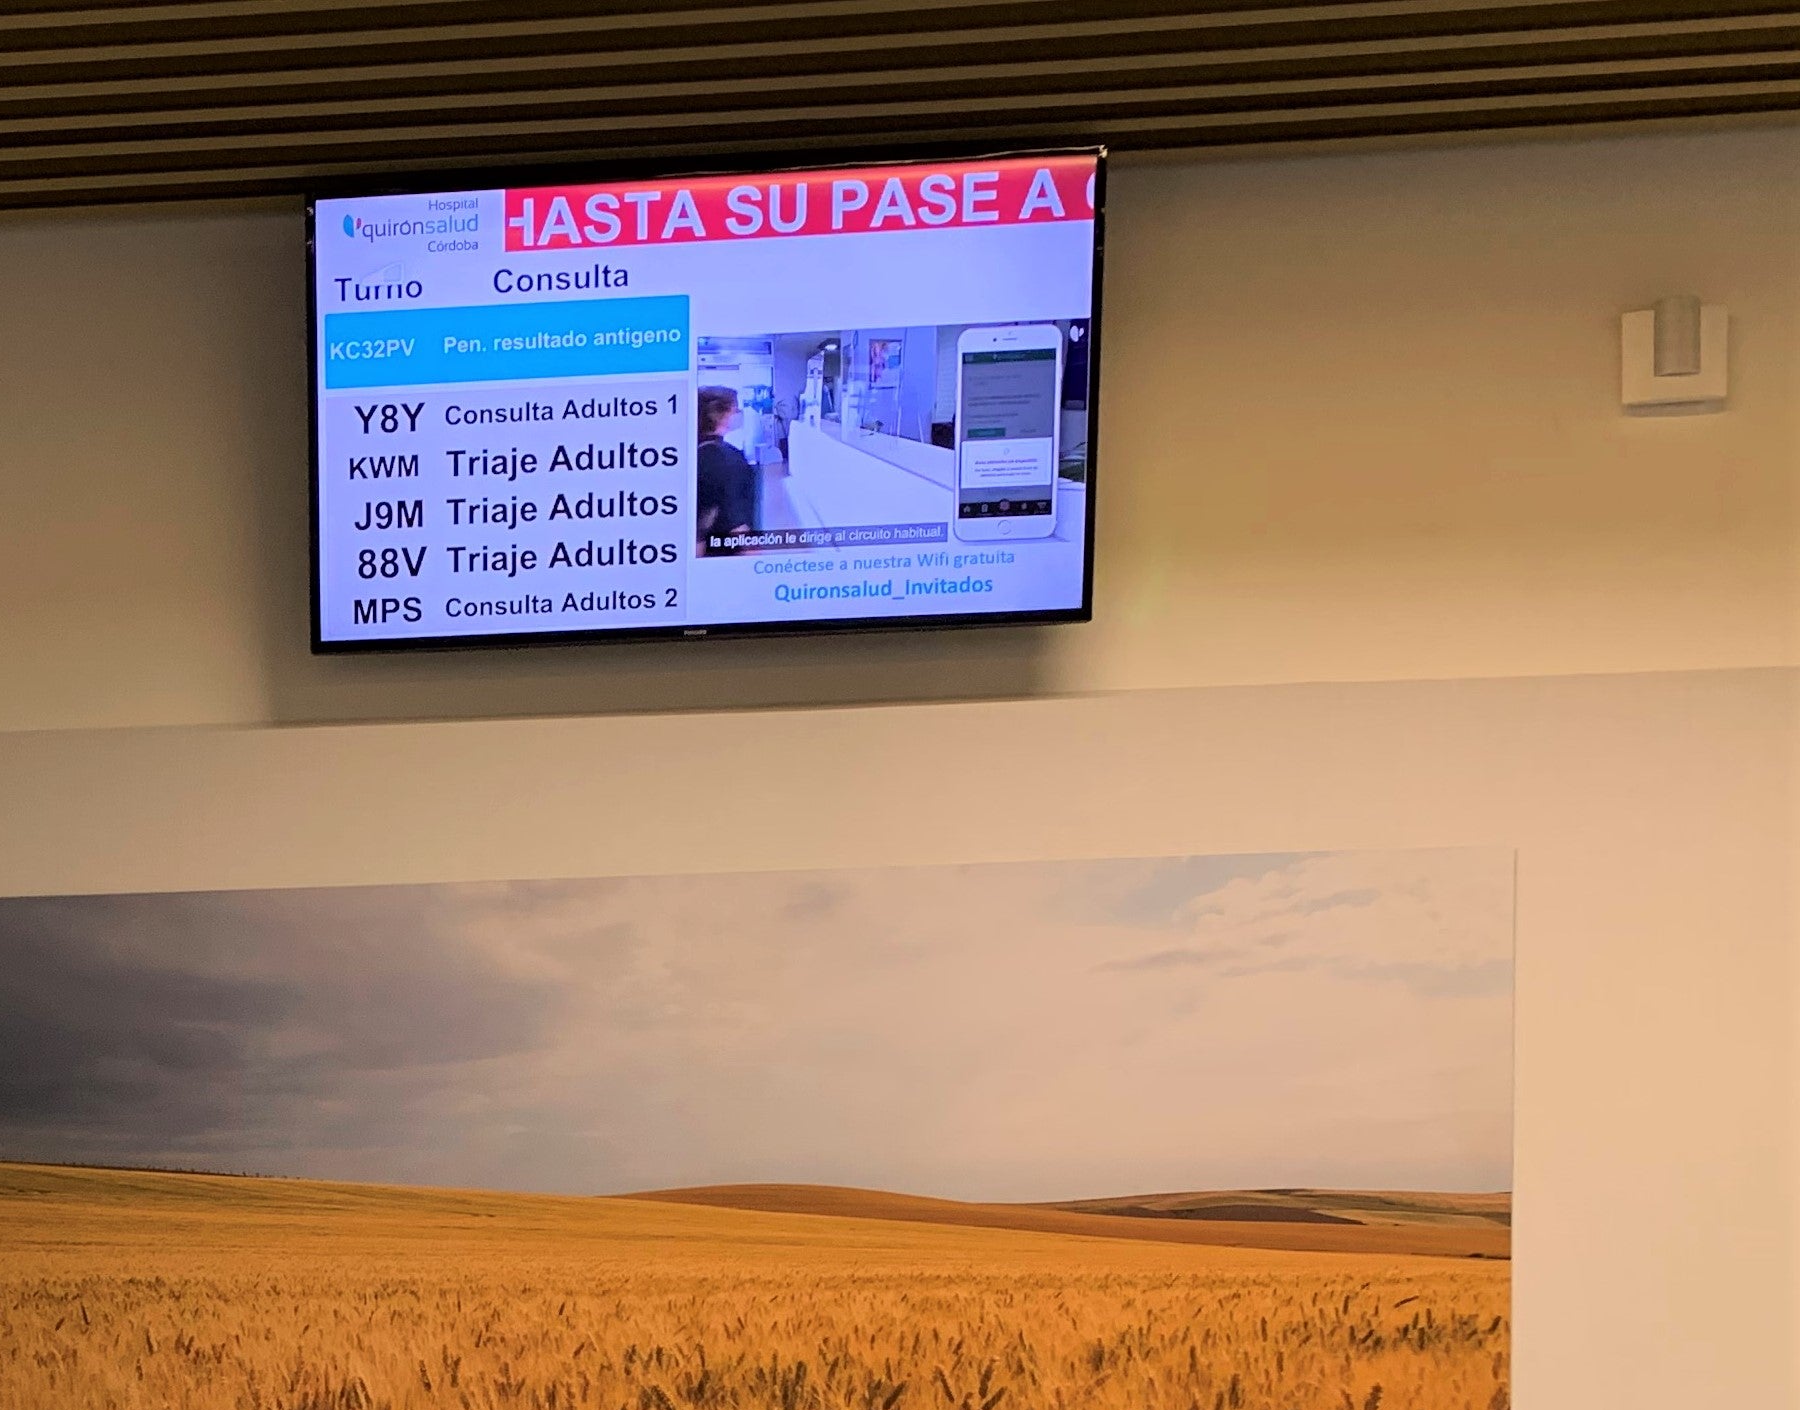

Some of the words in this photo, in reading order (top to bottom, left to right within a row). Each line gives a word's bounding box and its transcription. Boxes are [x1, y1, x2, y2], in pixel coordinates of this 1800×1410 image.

[428, 198, 478, 211] Hospital
[725, 183, 808, 236] SU
[832, 171, 1000, 229] PASE
[1018, 168, 1065, 219] A
[362, 214, 478, 243] quirónsalud
[428, 240, 478, 252] Córdoba
[493, 264, 629, 293] Consulta
[330, 338, 416, 360] KC32PV
[444, 336, 486, 354] Pen.
[494, 329, 587, 351] resultado
[354, 402, 425, 435] Y8Y
[445, 401, 554, 426] Consulta
[562, 397, 658, 420] Adultos
[667, 394, 677, 414] 1
[349, 455, 419, 480] KWM
[447, 448, 537, 481] Triaje
[549, 442, 678, 472] Adultos
[354, 500, 423, 531] J9M
[447, 496, 537, 530] Triaje
[549, 490, 678, 521] Adultos
[710, 535, 721, 547] la
[724, 533, 782, 549] aplicación
[785, 532, 796, 544] le
[799, 530, 832, 545] dirige
[835, 529, 846, 541] al
[849, 527, 891, 541] circuito
[358, 546, 427, 579] 88V
[447, 544, 537, 578] Triaje
[549, 539, 677, 569] Adultos
[753, 558, 834, 575] Conéctese
[839, 560, 848, 571] a
[853, 554, 911, 570] nuestra
[917, 551, 949, 568] Wifi
[953, 550, 1015, 569] gratuita
[775, 576, 993, 602] Quironsalud_Invitados
[354, 597, 422, 625] MPS
[446, 595, 552, 618] Consulta
[561, 590, 656, 613] Adultos
[665, 588, 677, 608] 2
